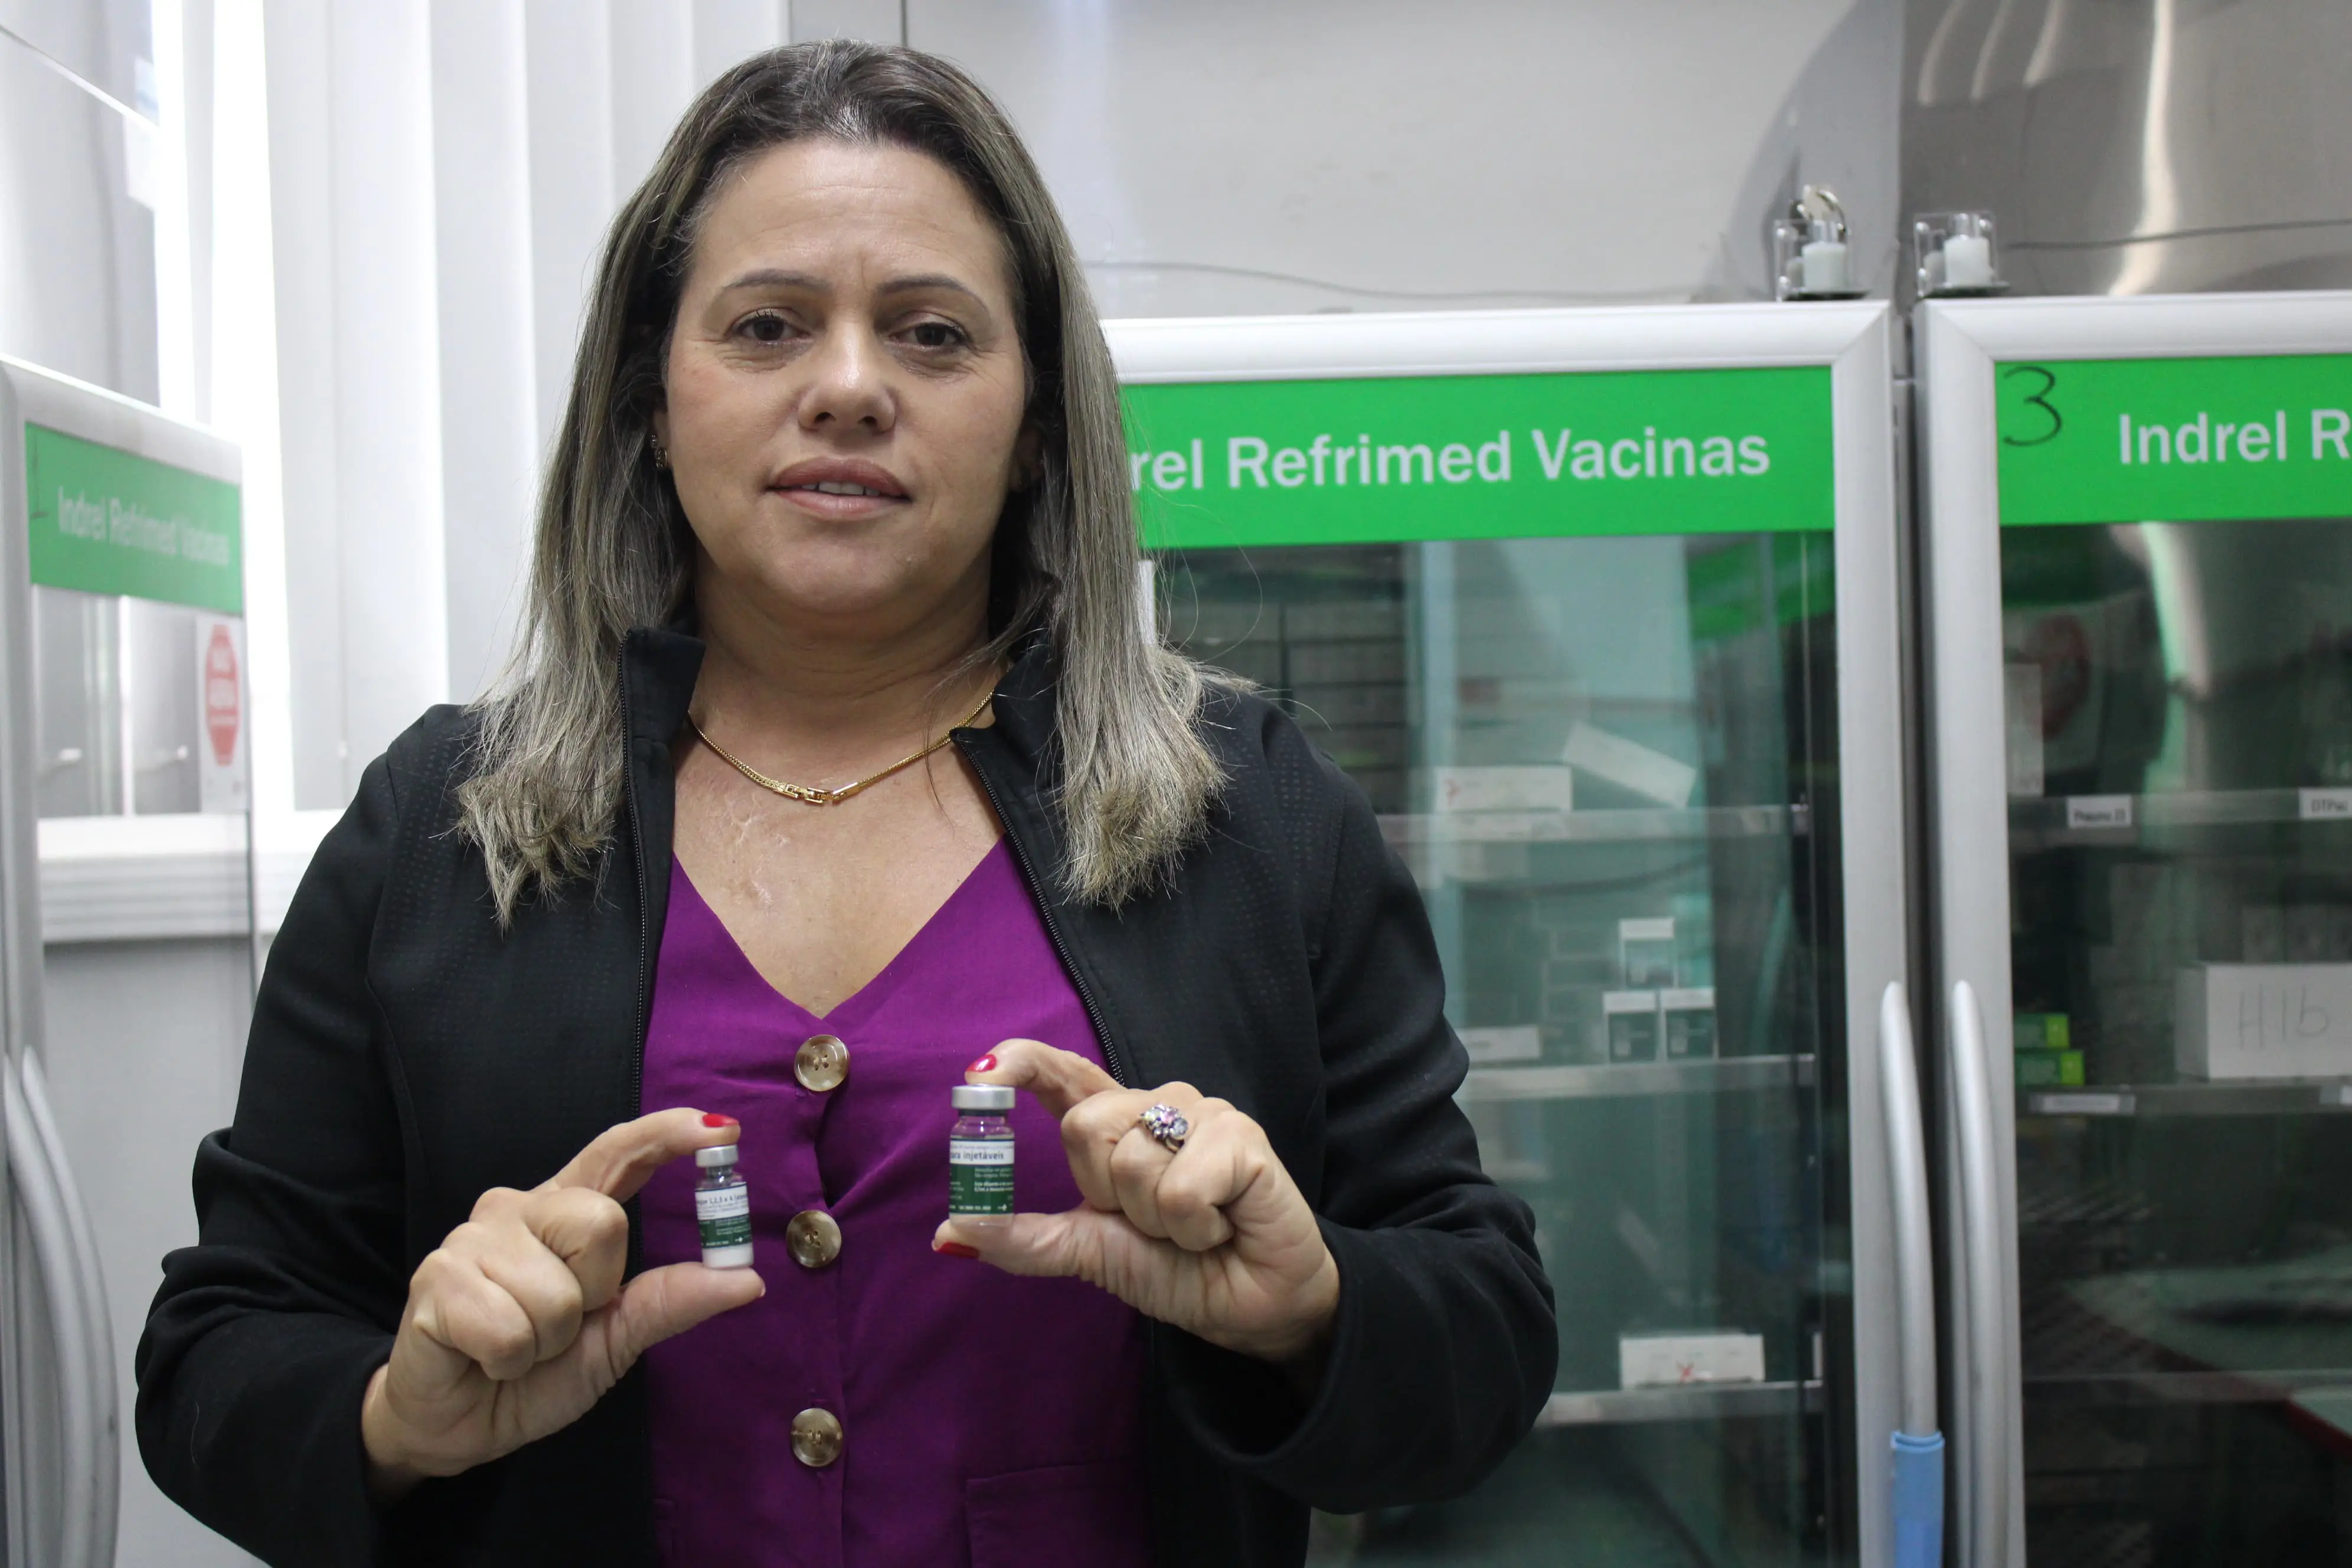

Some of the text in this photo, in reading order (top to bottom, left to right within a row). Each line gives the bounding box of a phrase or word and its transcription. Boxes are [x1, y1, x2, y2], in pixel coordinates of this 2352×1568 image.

[2003, 365, 2062, 446] 3
[2119, 410, 2288, 465] Indrel
[1131, 426, 1770, 491] rel Refrimed Vacinas
